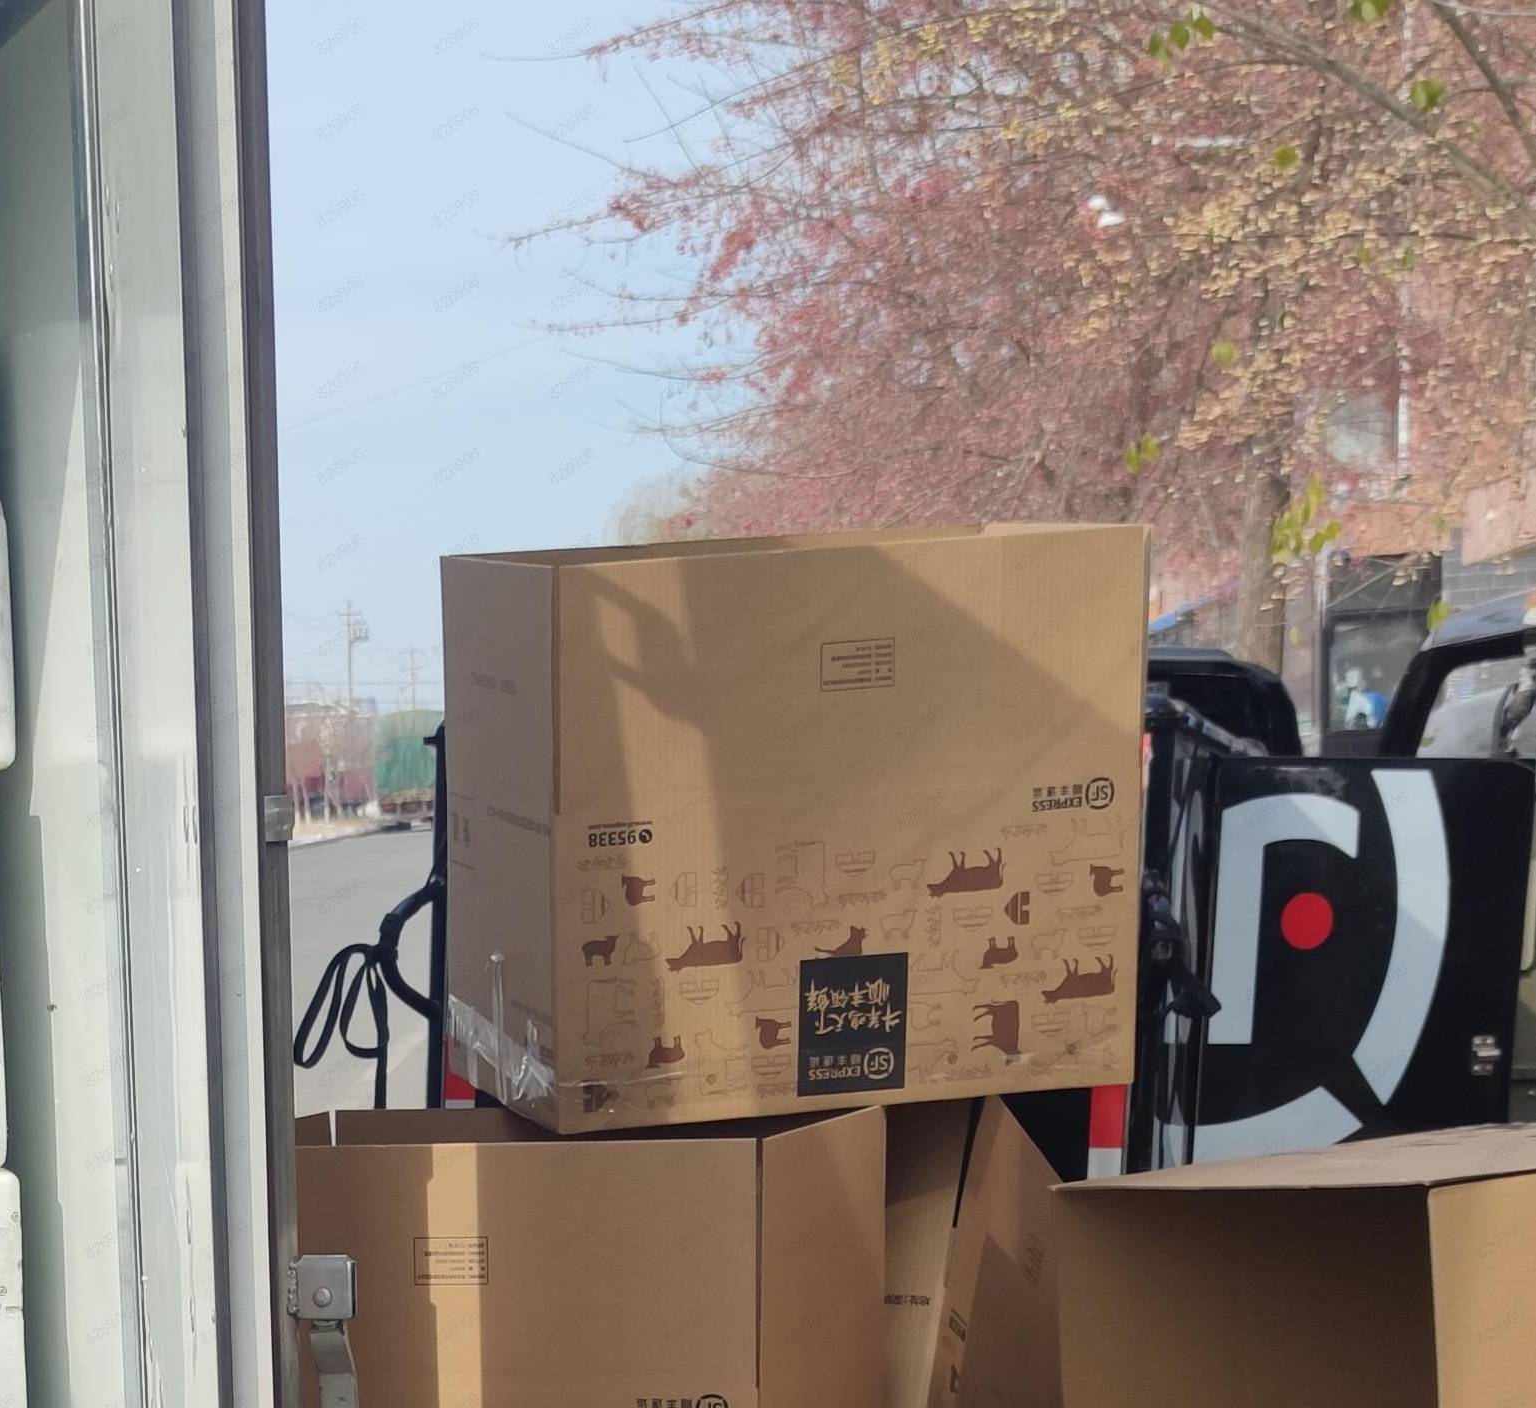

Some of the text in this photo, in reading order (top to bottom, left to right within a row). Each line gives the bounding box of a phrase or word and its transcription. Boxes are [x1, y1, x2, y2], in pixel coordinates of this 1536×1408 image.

[1031, 796, 1083, 812] EXPRESS
[587, 830, 637, 848] 95338
[808, 1065, 862, 1081] EXPRESS
